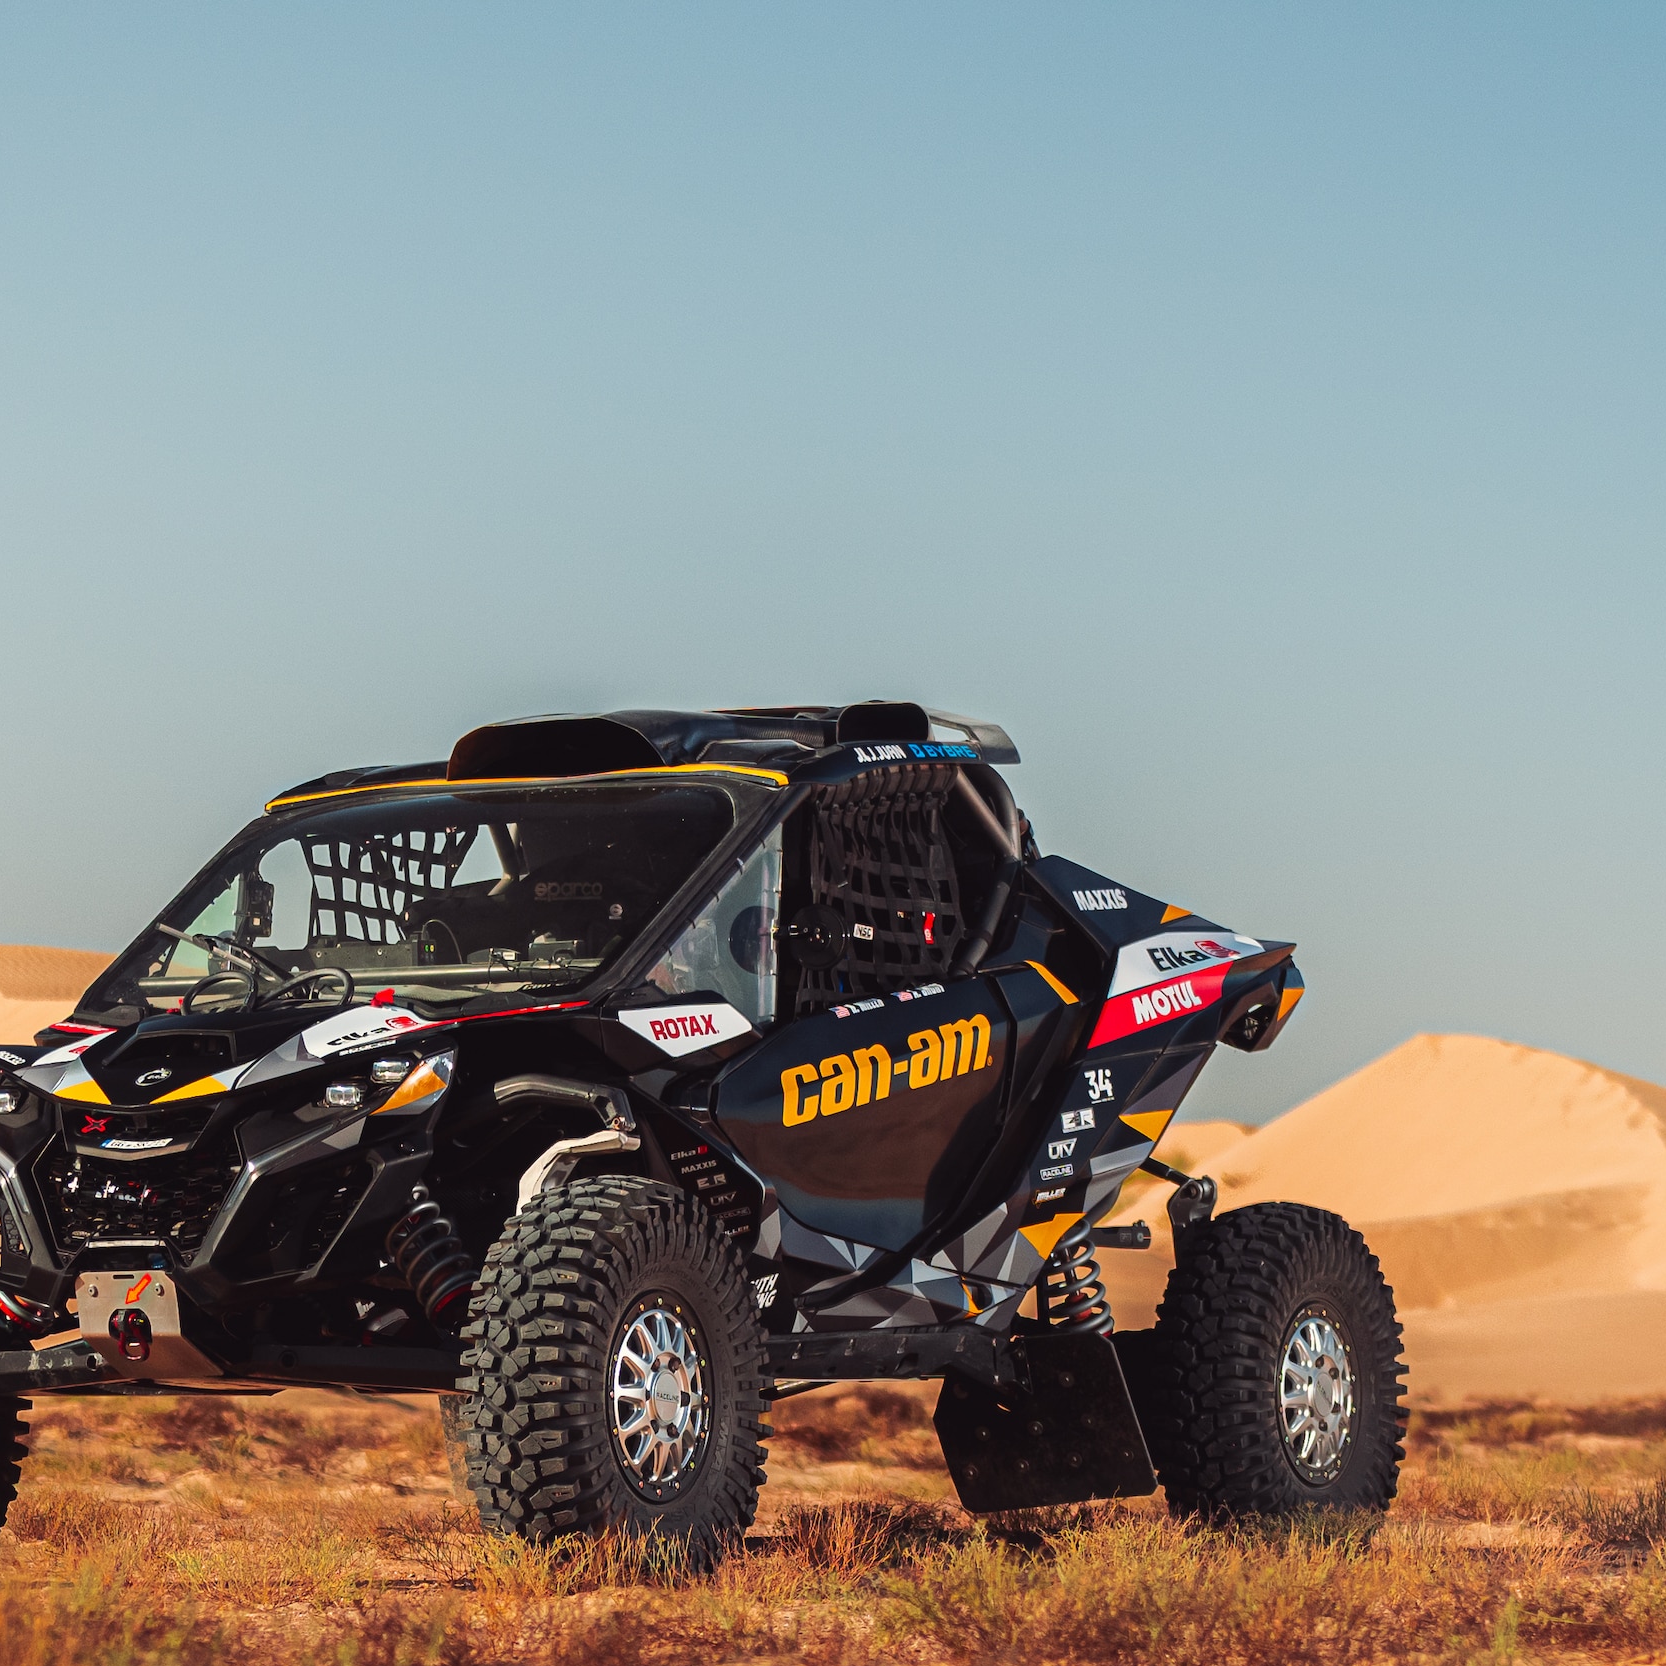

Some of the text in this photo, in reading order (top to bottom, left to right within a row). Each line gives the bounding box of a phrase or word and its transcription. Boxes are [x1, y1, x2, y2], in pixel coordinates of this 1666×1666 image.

[923, 745, 977, 759] BYBRE
[1072, 888, 1128, 911] MAXXIS
[1146, 947, 1211, 972] Elka
[1132, 980, 1202, 1025] MOTUL
[649, 1014, 718, 1040] ROTAX
[780, 1013, 992, 1128] can-am
[671, 1150, 696, 1161] Elka
[681, 1160, 717, 1174] MAXXIS
